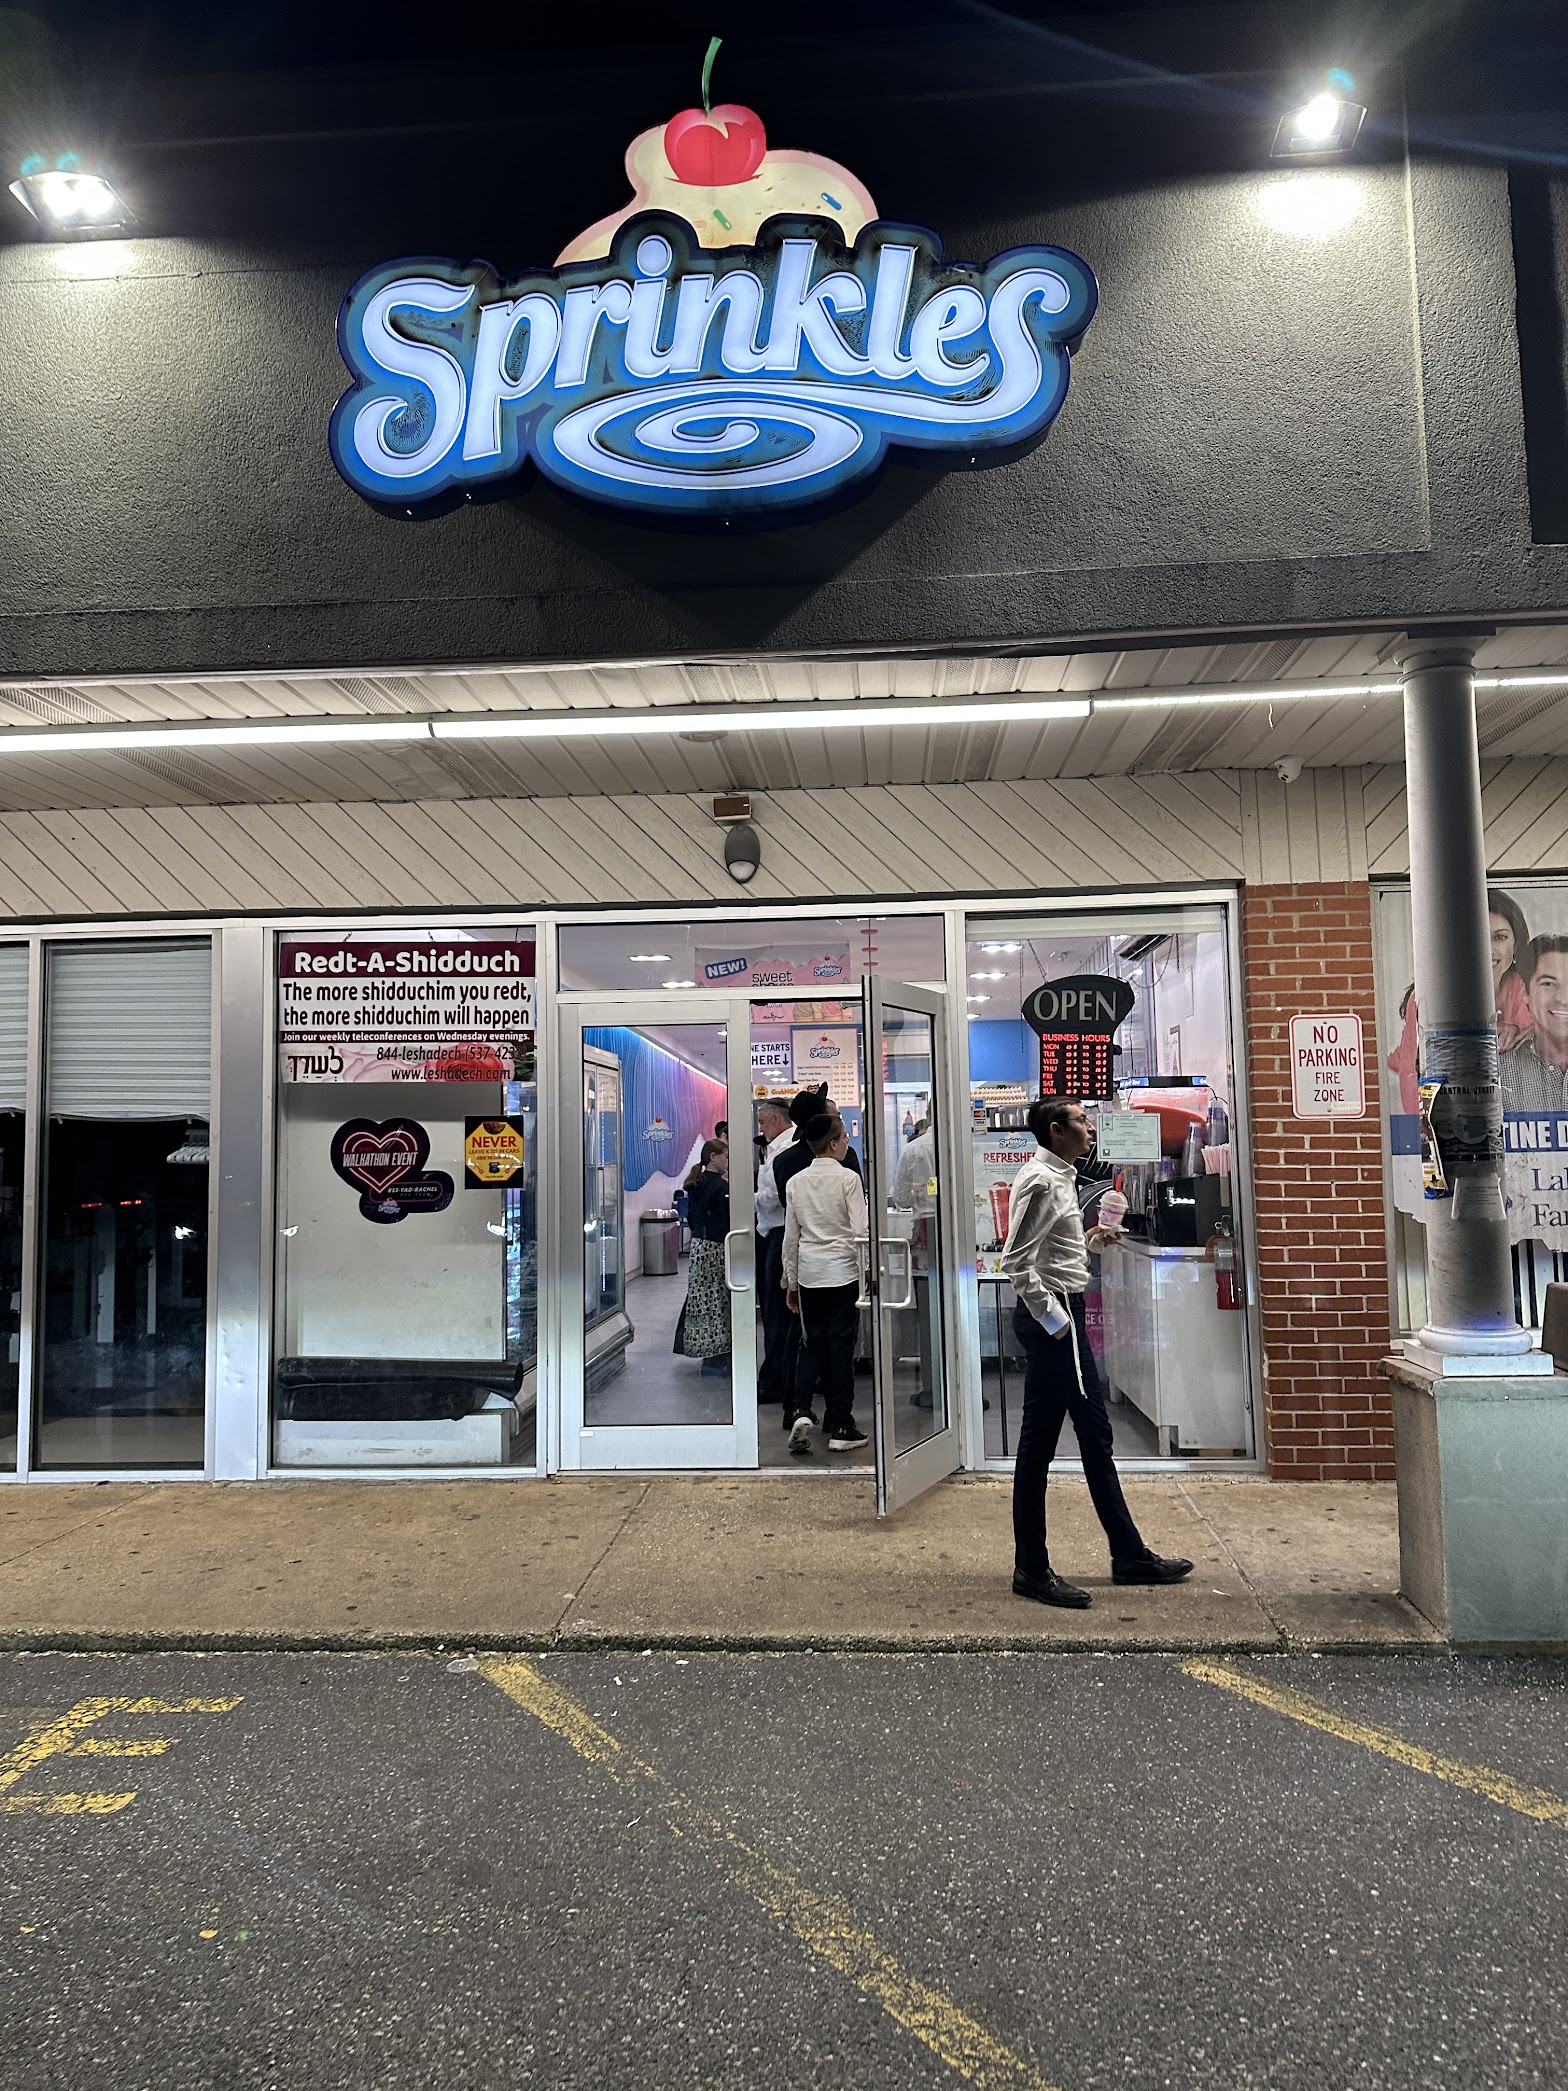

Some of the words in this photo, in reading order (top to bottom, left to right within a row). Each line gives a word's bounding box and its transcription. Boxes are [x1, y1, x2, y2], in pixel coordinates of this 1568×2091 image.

[352, 233, 1072, 490] Sprinkles
[294, 949, 520, 974] Redt-A-Shidduch
[706, 959, 745, 978] NEW!
[752, 970, 793, 983] sweet
[283, 982, 312, 1001] The
[316, 985, 358, 1001] more
[362, 980, 456, 1001] shidduchim
[459, 985, 489, 1005] you
[493, 981, 532, 1003] redt,
[1033, 989, 1117, 1021] OPEN
[284, 1007, 309, 1025] the
[312, 1010, 350, 1025] more
[354, 1005, 440, 1025] shidduchim
[444, 1005, 470, 1025] will
[474, 1007, 530, 1029] happen
[283, 1033, 300, 1041] Join
[319, 1032, 351, 1043] weekly
[352, 1032, 422, 1041] teleconferences
[437, 1032, 487, 1043] Wednesday
[489, 1032, 530, 1043] evenings.
[1042, 1033, 1079, 1042] BUSINESS
[1081, 1034, 1111, 1043] HOURS
[1313, 1025, 1338, 1044] NO
[376, 1046, 462, 1060] 844-leshadech
[761, 1043, 790, 1052] STARTS
[751, 1055, 781, 1065] HERE
[1299, 1048, 1357, 1067] PARKING
[391, 1066, 511, 1081] www.leshadech.com
[1315, 1071, 1341, 1085] FIRE
[1314, 1089, 1345, 1102] ZONE
[1440, 1086, 1470, 1095] CENTRAL
[1503, 1121, 1552, 1149] TINE
[1557, 1120, 1568, 1148] D
[472, 1136, 517, 1148] NEVER
[391, 1152, 418, 1166] EVENT
[983, 1152, 1036, 1163] REFRESHE
[1531, 1167, 1568, 1191] La
[1531, 1203, 1568, 1227] Fa
